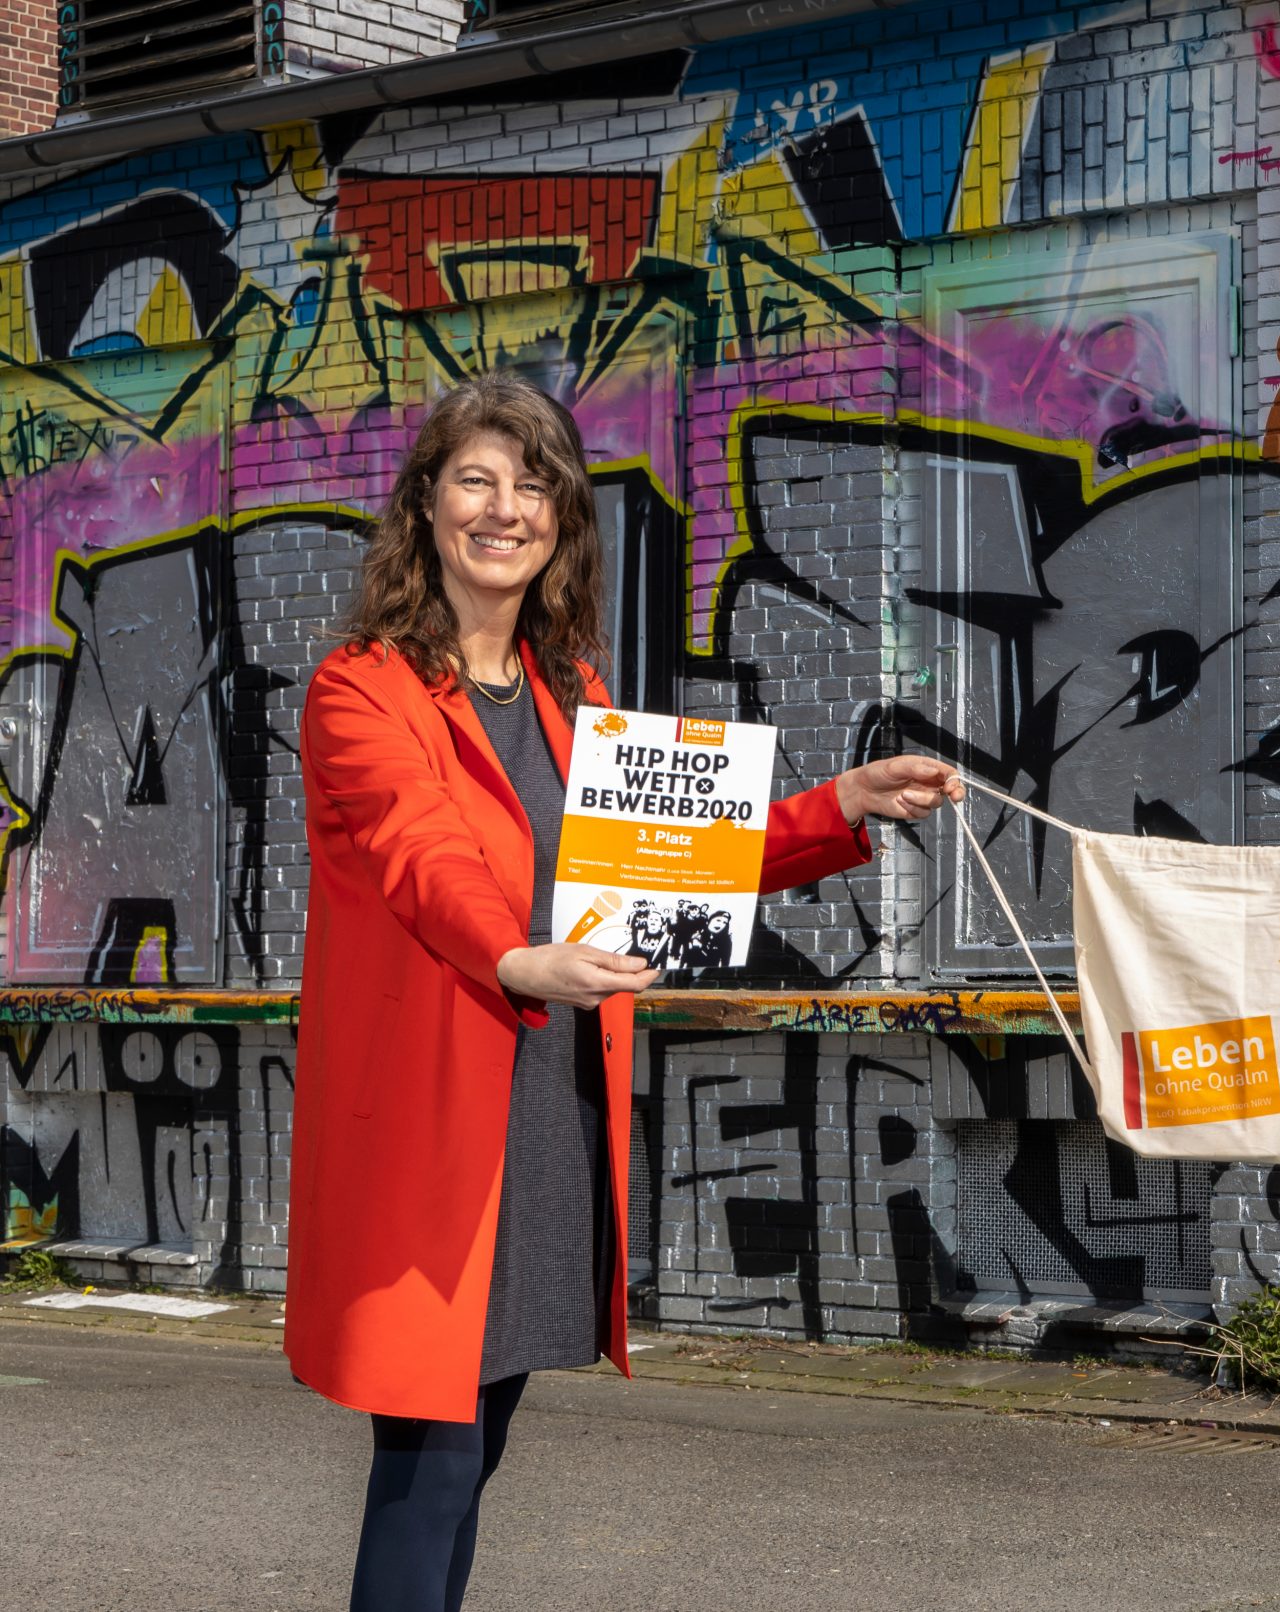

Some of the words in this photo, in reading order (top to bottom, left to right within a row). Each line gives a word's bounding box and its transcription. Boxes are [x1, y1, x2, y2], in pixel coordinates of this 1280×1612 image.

[686, 719, 723, 732] Leben
[615, 744, 665, 769] HIP
[671, 750, 730, 774] HOP
[623, 768, 696, 796] WETT
[580, 786, 753, 821] BEWERB2020
[637, 828, 650, 842] 3.
[655, 830, 693, 846] Platz
[684, 850, 692, 858] C)
[1150, 1034, 1266, 1073] Leben
[1154, 1074, 1202, 1096] ohne
[1207, 1068, 1268, 1090] Qualm
[1156, 1109, 1175, 1120] LoQ
[1250, 1096, 1272, 1107] NRW
